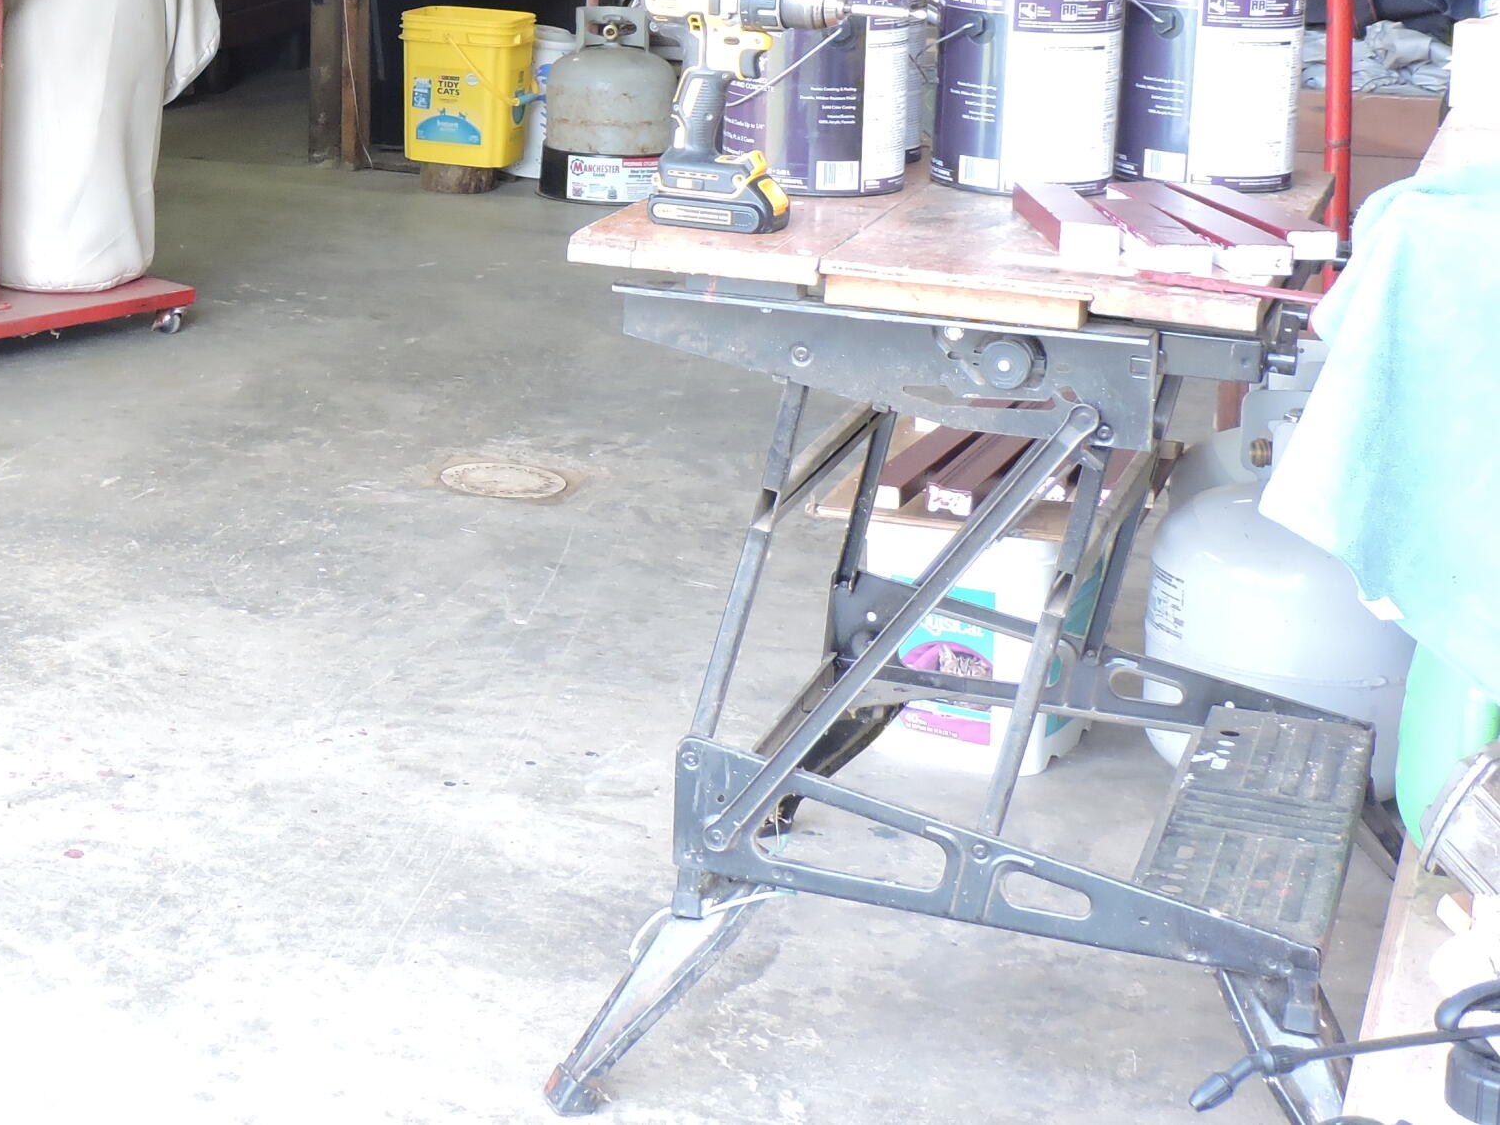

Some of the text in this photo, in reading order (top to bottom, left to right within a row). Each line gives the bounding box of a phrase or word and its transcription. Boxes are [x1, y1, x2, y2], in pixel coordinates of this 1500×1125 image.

[438, 80, 460, 89] TIDY
[437, 87, 460, 96] CATS
[573, 162, 620, 174] MANCHESTER
